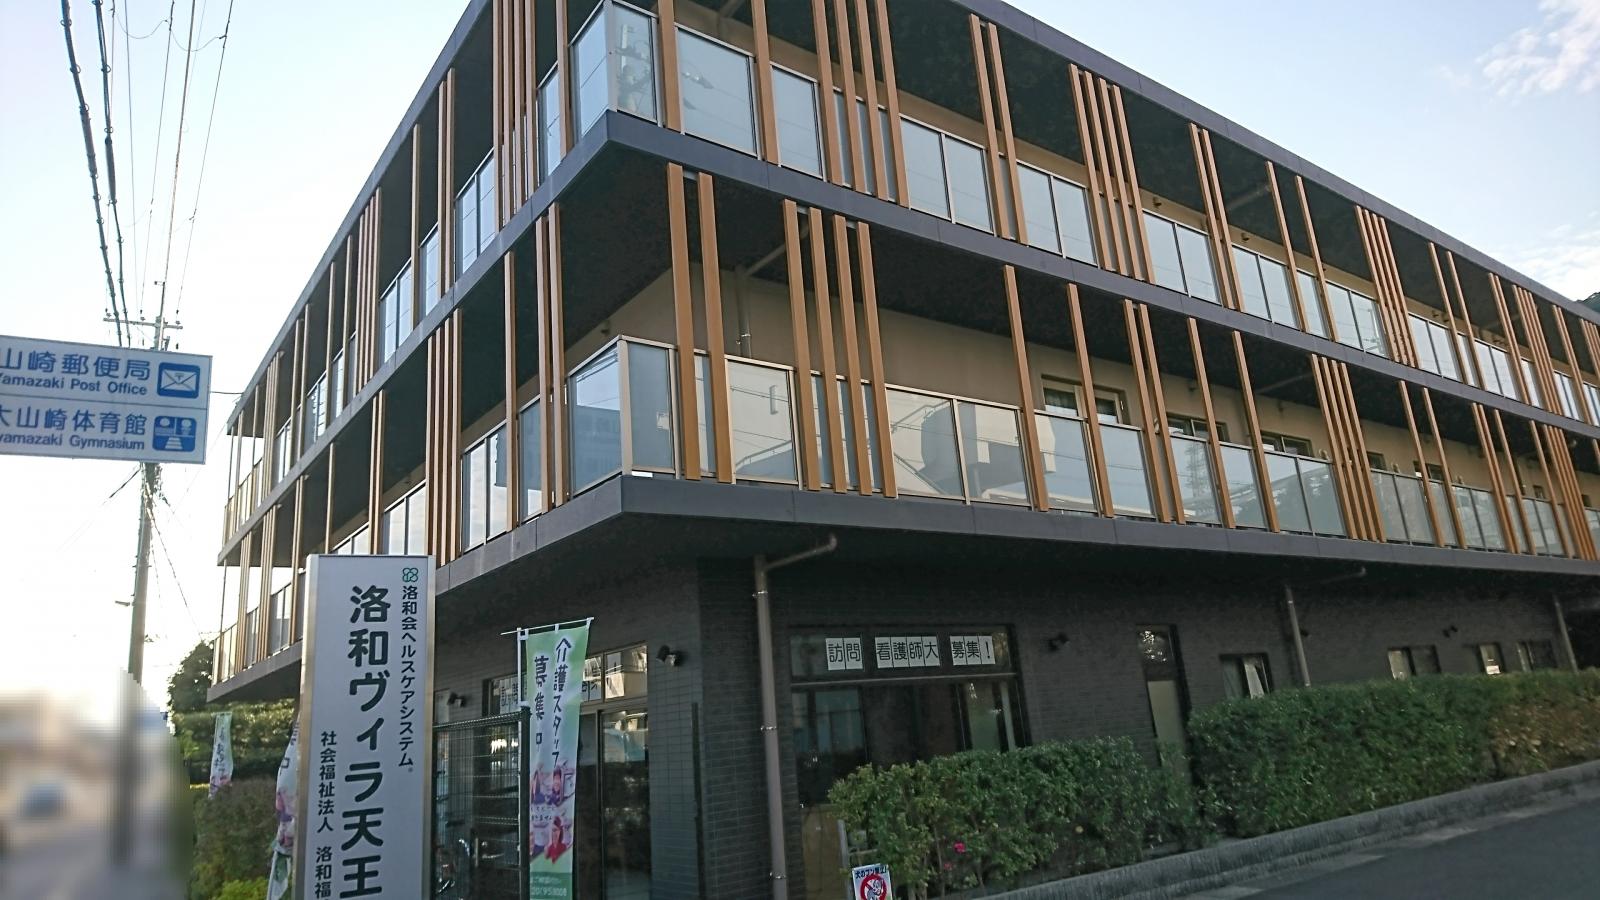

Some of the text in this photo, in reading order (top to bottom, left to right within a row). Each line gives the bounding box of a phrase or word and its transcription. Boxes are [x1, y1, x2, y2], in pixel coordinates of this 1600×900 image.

[0, 348, 151, 381] 山崎郵便局
[71, 378, 101, 392] Post
[108, 381, 148, 396] Office
[0, 404, 148, 436] 大山崎体育館
[69, 435, 145, 450] Gymnasium
[828, 643, 861, 662] 訪問
[876, 641, 939, 661] 看護師大
[398, 585, 418, 768] 洛和会ヘルスケアシステム
[551, 637, 572, 768] 介護スタッフ
[339, 584, 391, 899] 洛和ヴィラ天王
[317, 730, 338, 834] 社会福祉法人
